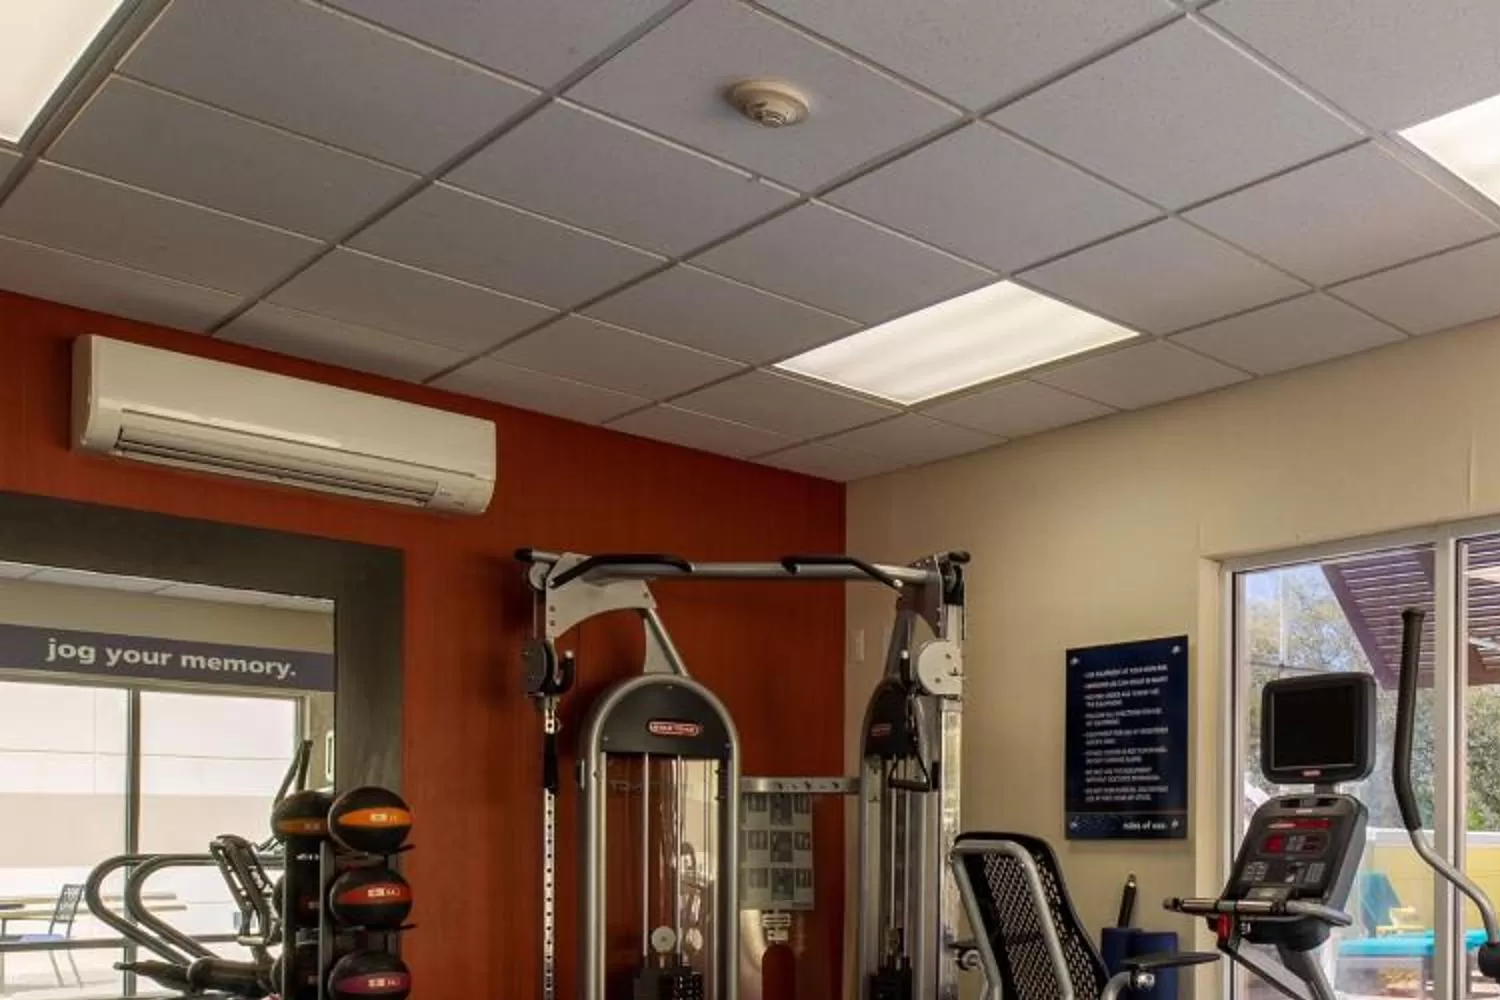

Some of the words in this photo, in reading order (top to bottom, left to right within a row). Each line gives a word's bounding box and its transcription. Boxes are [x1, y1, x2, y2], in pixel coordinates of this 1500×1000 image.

[45, 637, 96, 664] jog
[105, 647, 173, 667] your
[181, 655, 297, 680] memory.
